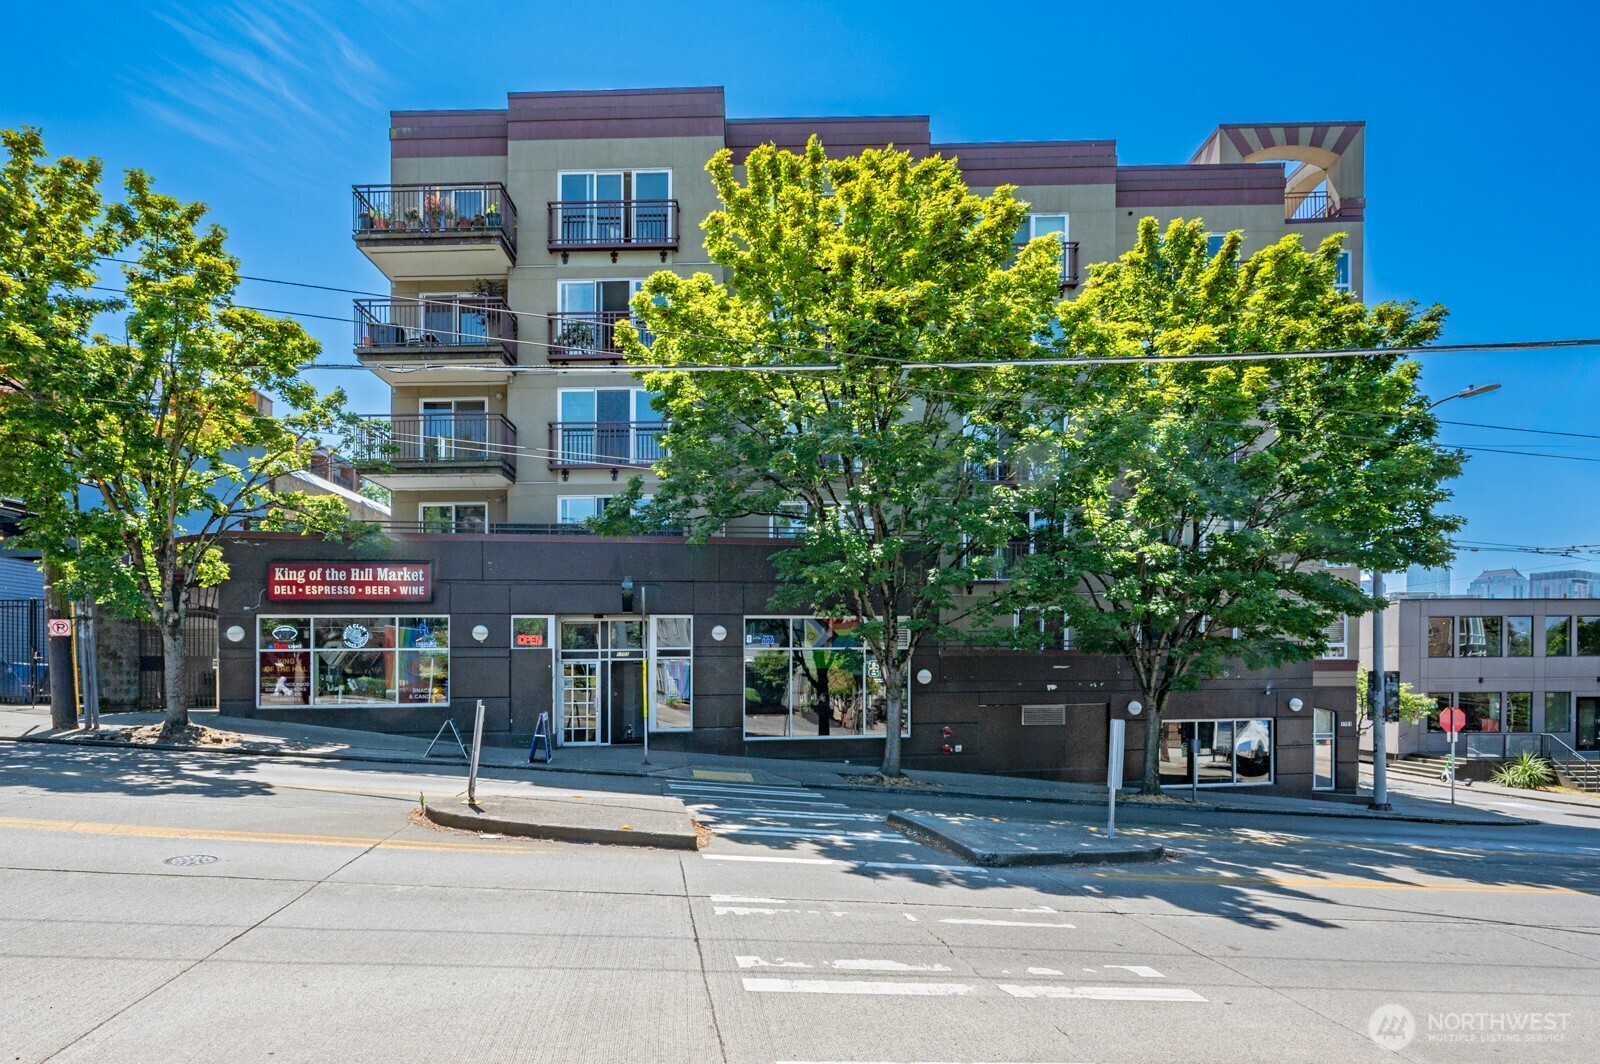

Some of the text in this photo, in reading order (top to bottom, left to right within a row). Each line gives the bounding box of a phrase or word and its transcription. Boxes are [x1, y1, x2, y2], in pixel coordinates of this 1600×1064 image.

[274, 567, 425, 584] King of the Hill Market
[274, 585, 425, 595] DELI ESPRESSO BEER WINE
[517, 634, 543, 646] OPEN
